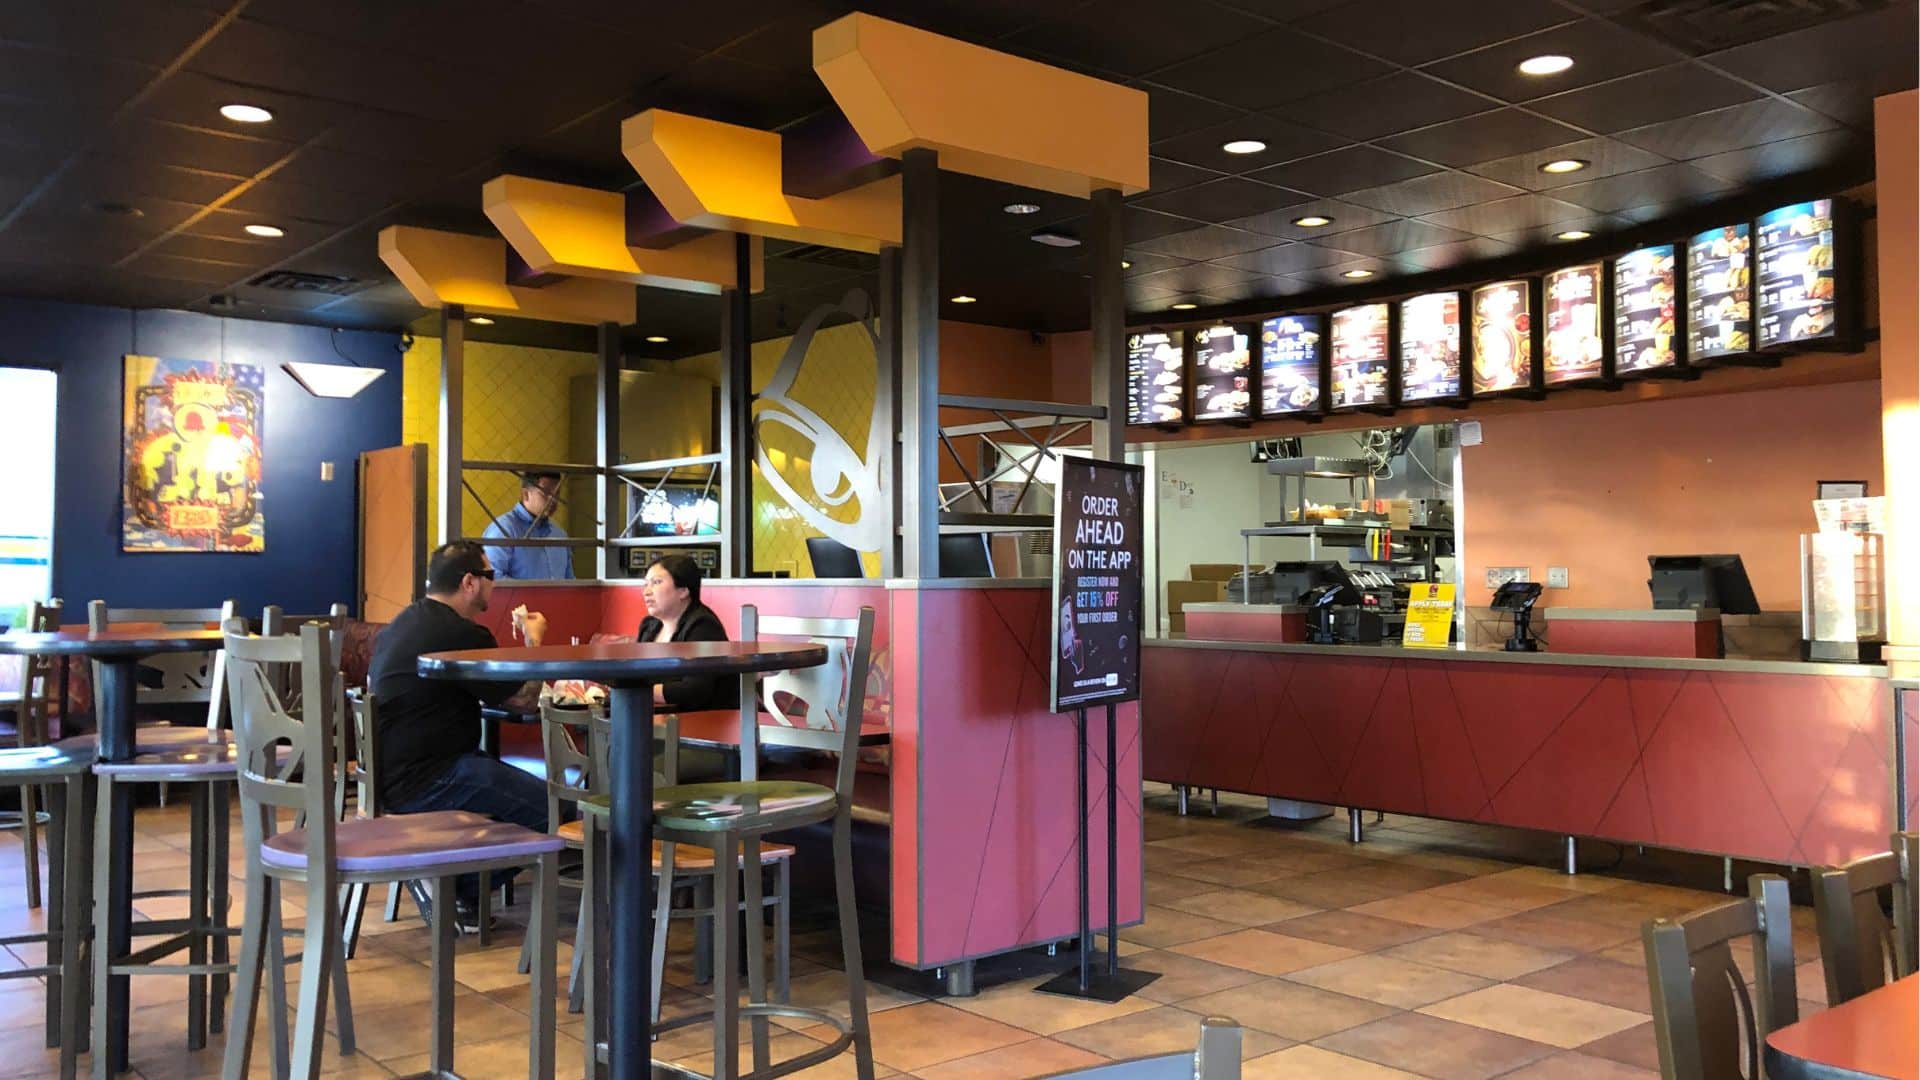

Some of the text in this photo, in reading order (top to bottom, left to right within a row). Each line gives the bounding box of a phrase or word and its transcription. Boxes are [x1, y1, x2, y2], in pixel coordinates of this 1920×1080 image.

[1081, 495, 1119, 517] ORDER
[1075, 518, 1124, 545] AHEAD
[1068, 549, 1131, 569] ON THE APP
[1077, 576, 1119, 587] REGISTER NOW AND
[1076, 591, 1119, 608] GET 15% OFF
[1077, 611, 1118, 624] YOUR FIRST ORDER
